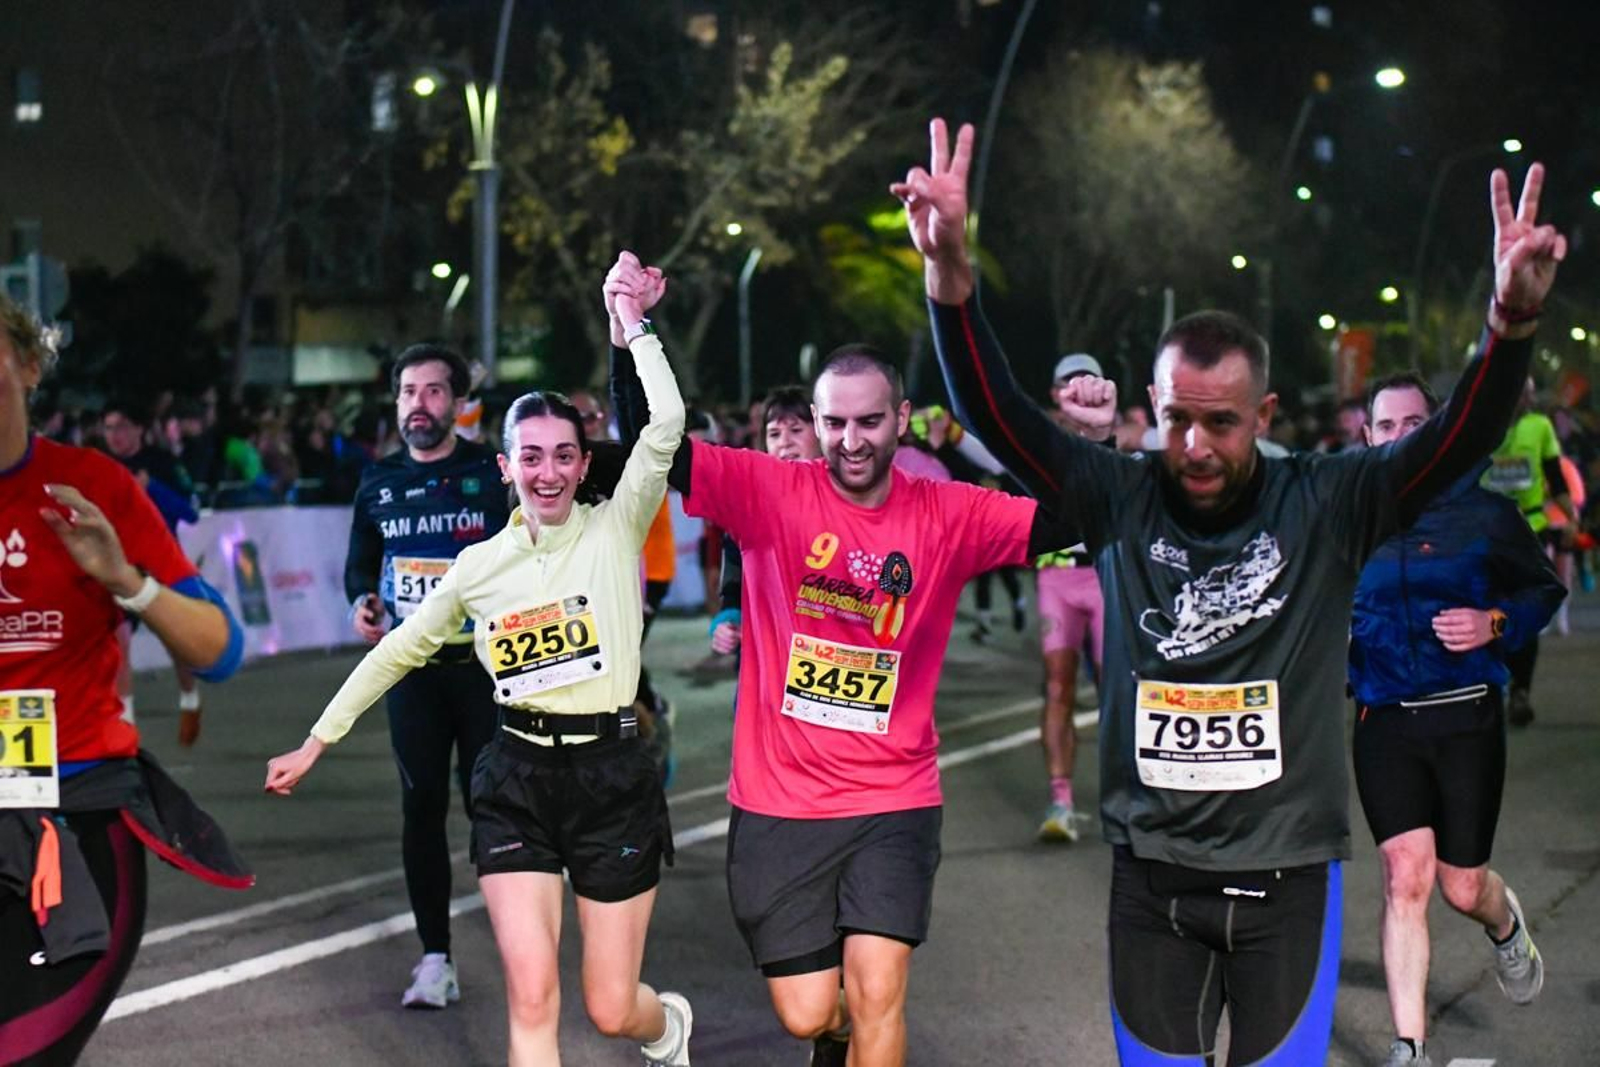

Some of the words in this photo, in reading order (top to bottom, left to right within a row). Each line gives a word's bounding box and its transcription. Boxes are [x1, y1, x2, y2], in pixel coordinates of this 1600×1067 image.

[380, 517, 410, 539] SAN
[416, 508, 485, 534] ANTÓN
[805, 532, 839, 570] 9
[798, 585, 879, 618] UNIVERSIDAD
[802, 574, 875, 602] CARRERA
[502, 614, 523, 631] 42
[495, 618, 589, 667] 3250
[814, 645, 836, 662] 42
[795, 660, 888, 701] 3457
[1164, 688, 1187, 708] 42
[1148, 713, 1265, 750] 7956
